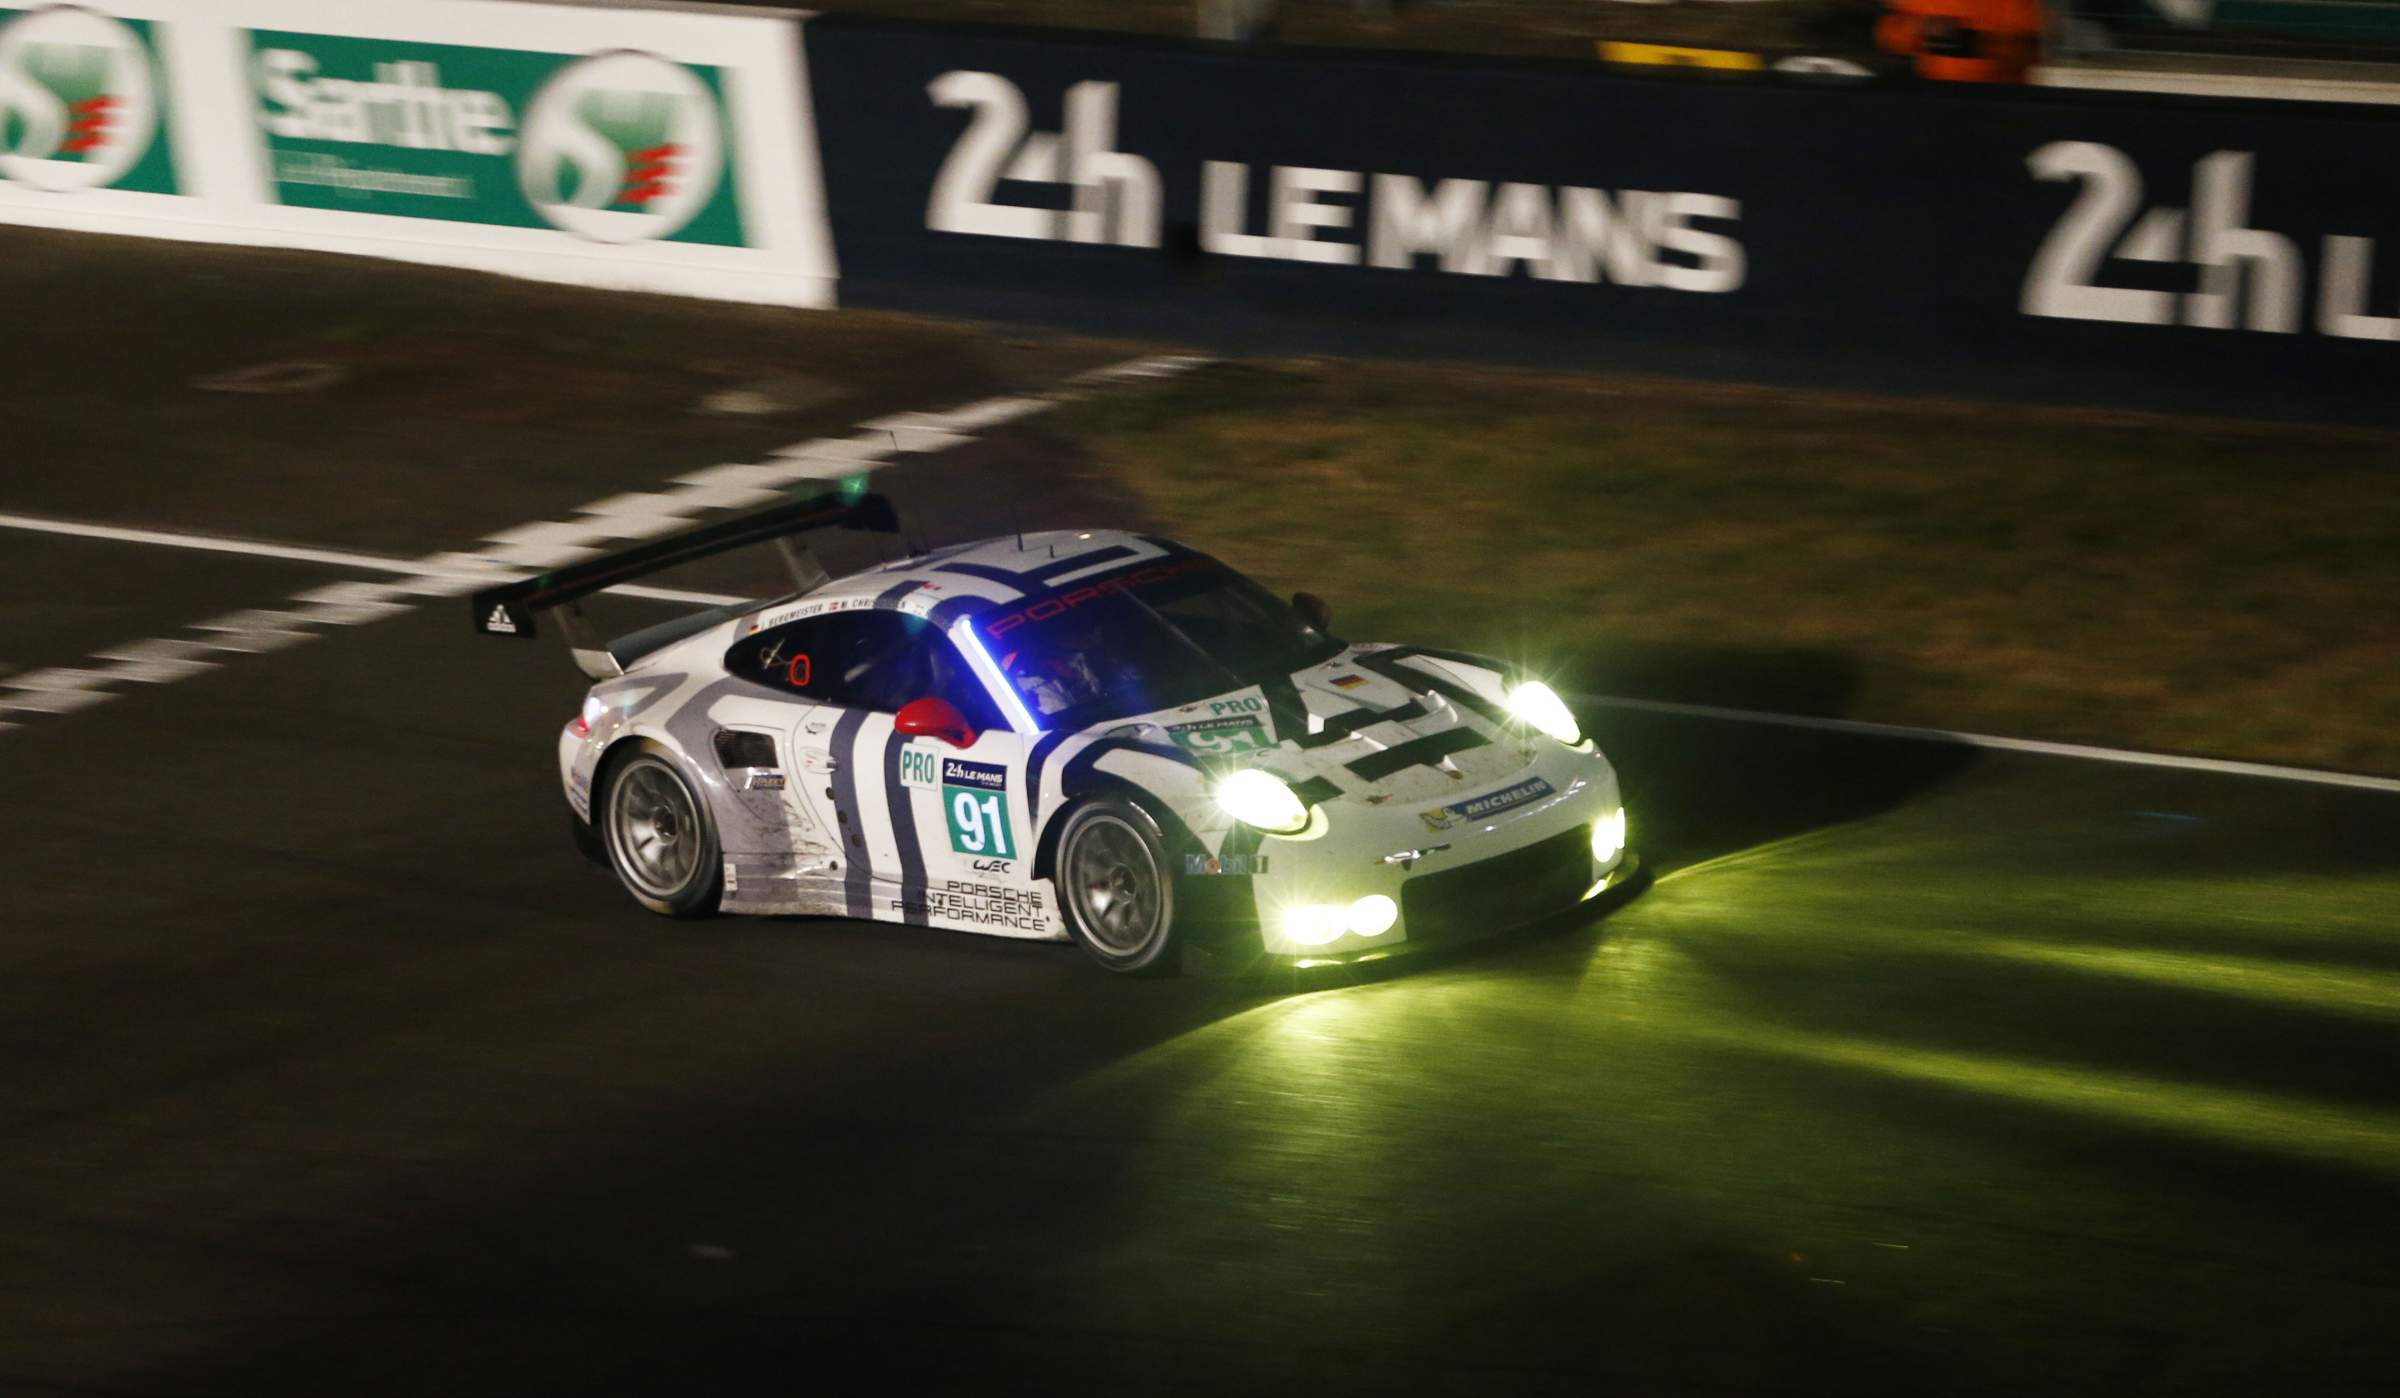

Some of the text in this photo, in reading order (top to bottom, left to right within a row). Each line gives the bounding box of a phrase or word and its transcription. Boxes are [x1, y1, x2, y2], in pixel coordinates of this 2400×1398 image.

[258, 48, 516, 156] Sarthe
[1200, 160, 1362, 266] LE
[1368, 172, 1748, 294] MANS
[1209, 696, 1261, 715] PRO
[902, 750, 935, 784] PRO
[965, 770, 977, 780] LE
[977, 772, 1003, 783] MANS
[1466, 779, 1547, 815] MICHELIN
[954, 792, 1007, 855] 91
[973, 860, 1012, 874] WEC
[1185, 854, 1248, 876] Mobil
[918, 891, 1043, 917] INTELLIGENT
[947, 880, 1043, 904] PORSCHE
[892, 900, 1046, 932] PERFORMANCE
